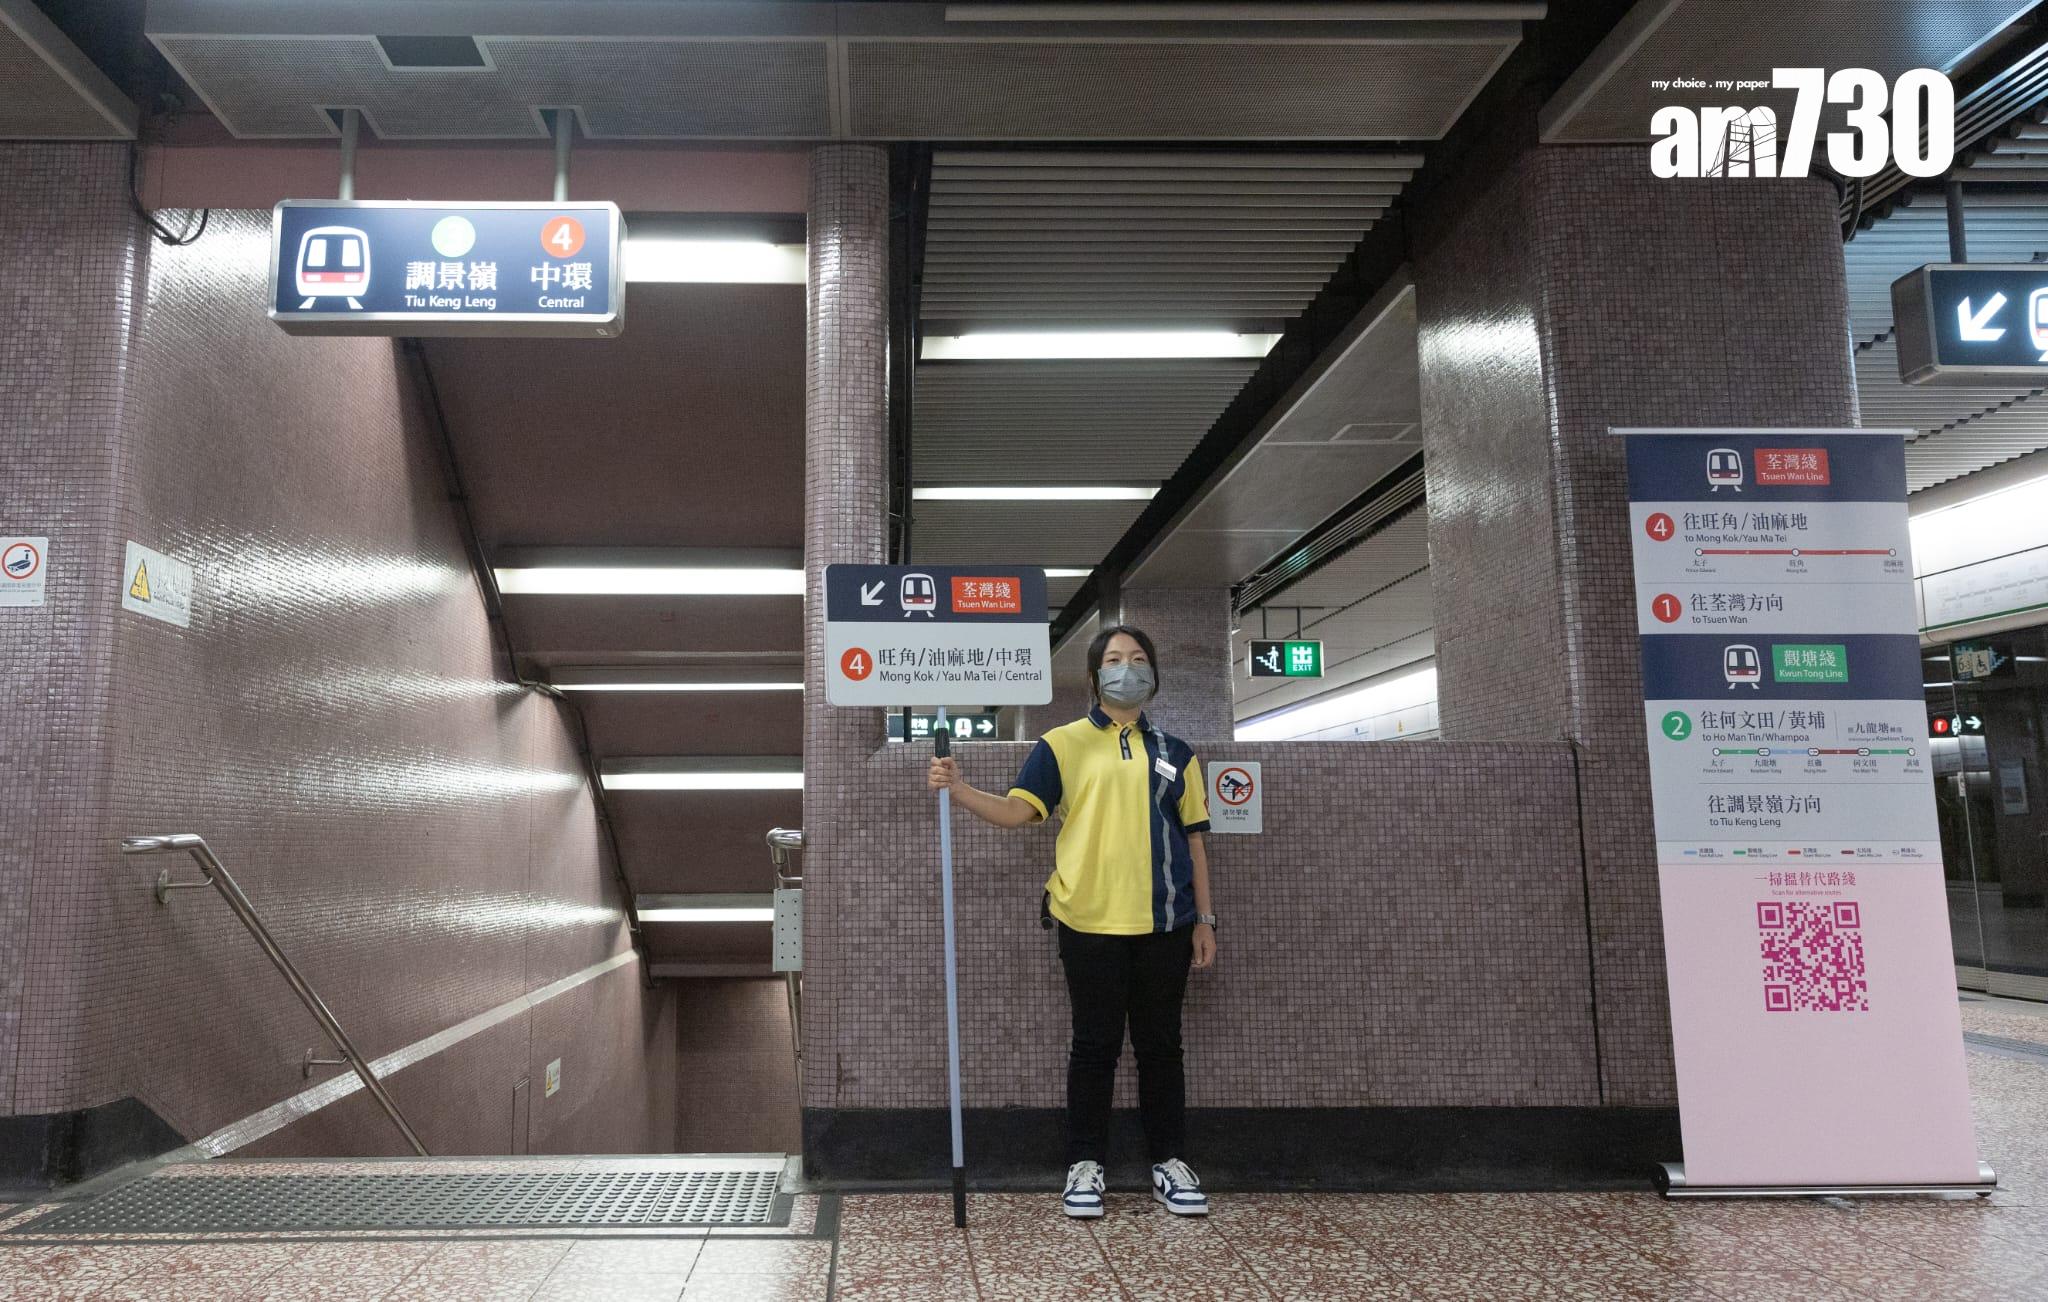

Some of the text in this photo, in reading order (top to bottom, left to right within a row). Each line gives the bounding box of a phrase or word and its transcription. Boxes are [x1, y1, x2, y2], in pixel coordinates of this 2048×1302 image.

[551, 223, 573, 250] 4
[405, 261, 498, 291] 調景嶺
[530, 261, 593, 292] 中環
[405, 296, 497, 310] Tiu Keng Leng
[538, 296, 584, 308] Central
[1761, 472, 1824, 482] Tsuen Wan Line
[1653, 518, 1668, 537] 4
[1682, 512, 1809, 531] 往旺角/油麻地
[1685, 534, 1695, 543] to
[1696, 534, 1721, 544] Mong
[1760, 534, 1774, 543] Ma
[1774, 534, 1787, 543] Tei
[957, 600, 1016, 609] Tsuen Wan Line
[1661, 600, 1672, 618] 1
[1690, 593, 1784, 613] 往荃灣方向
[1692, 615, 1748, 624] to Tsuen Wan
[849, 653, 865, 675] 4
[878, 647, 1032, 667] 旺角/油麻地/中環
[1292, 664, 1313, 672] EXIT
[1779, 669, 1843, 680] Kwun Tong Line
[879, 671, 911, 684] Mong
[913, 670, 934, 682] Kok
[942, 671, 961, 682] Yau
[963, 671, 980, 682] Ma
[981, 670, 997, 681] Tei
[1005, 670, 1042, 682] Central
[1670, 716, 1685, 736] 2
[1702, 734, 1712, 742] to
[1713, 733, 1725, 742] Ho
[1726, 733, 1747, 742] Man
[1707, 794, 1822, 814] 往調景嶺方向
[1709, 817, 1781, 829] to Tiu Keng Leng
